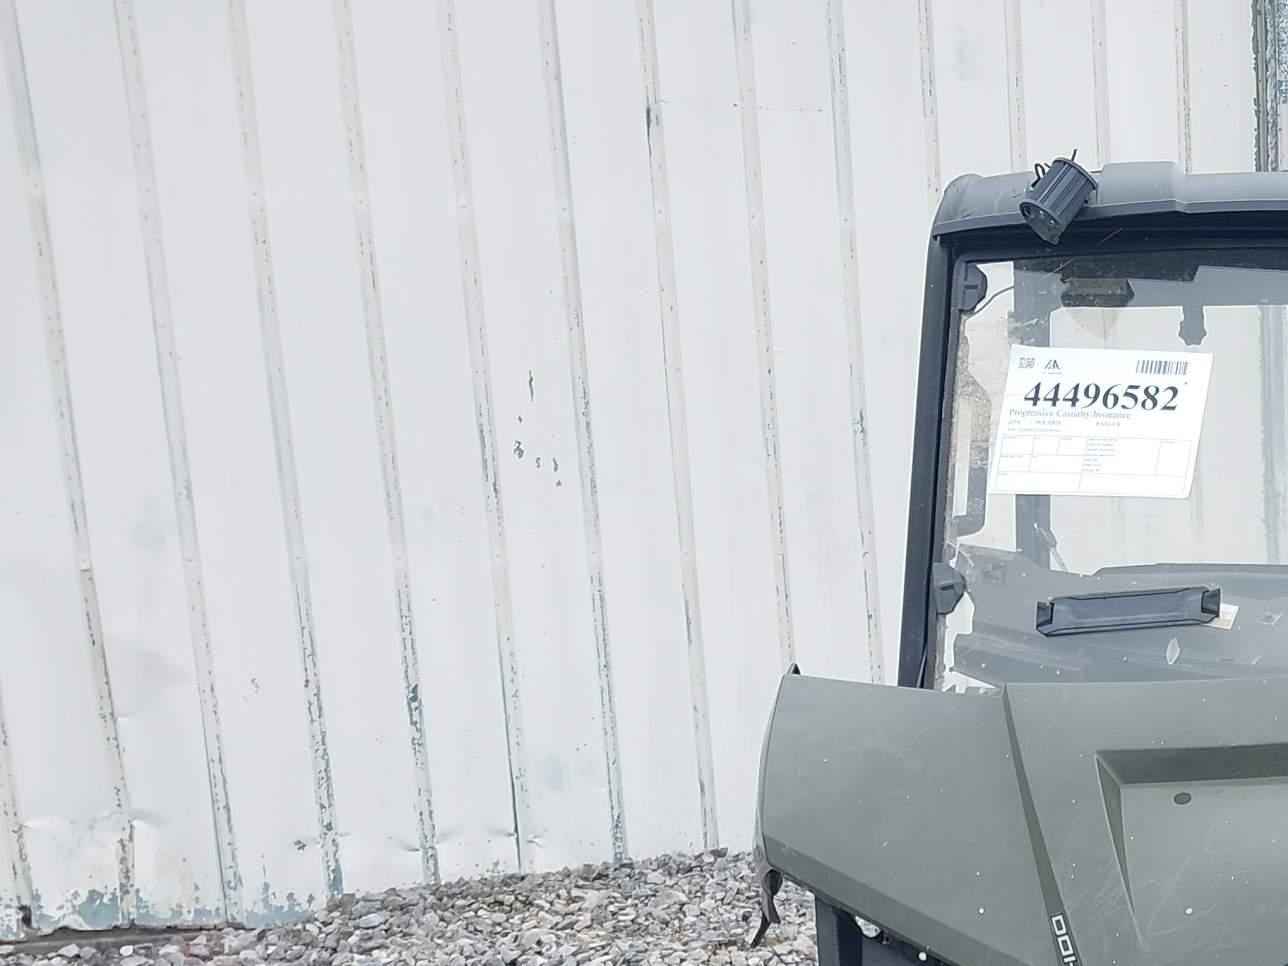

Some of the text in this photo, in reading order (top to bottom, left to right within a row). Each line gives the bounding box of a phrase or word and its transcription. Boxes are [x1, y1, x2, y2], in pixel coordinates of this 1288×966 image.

[1024, 382, 1178, 411] 44496582
[1009, 408, 1132, 420] Progressive Casualty Insurance
